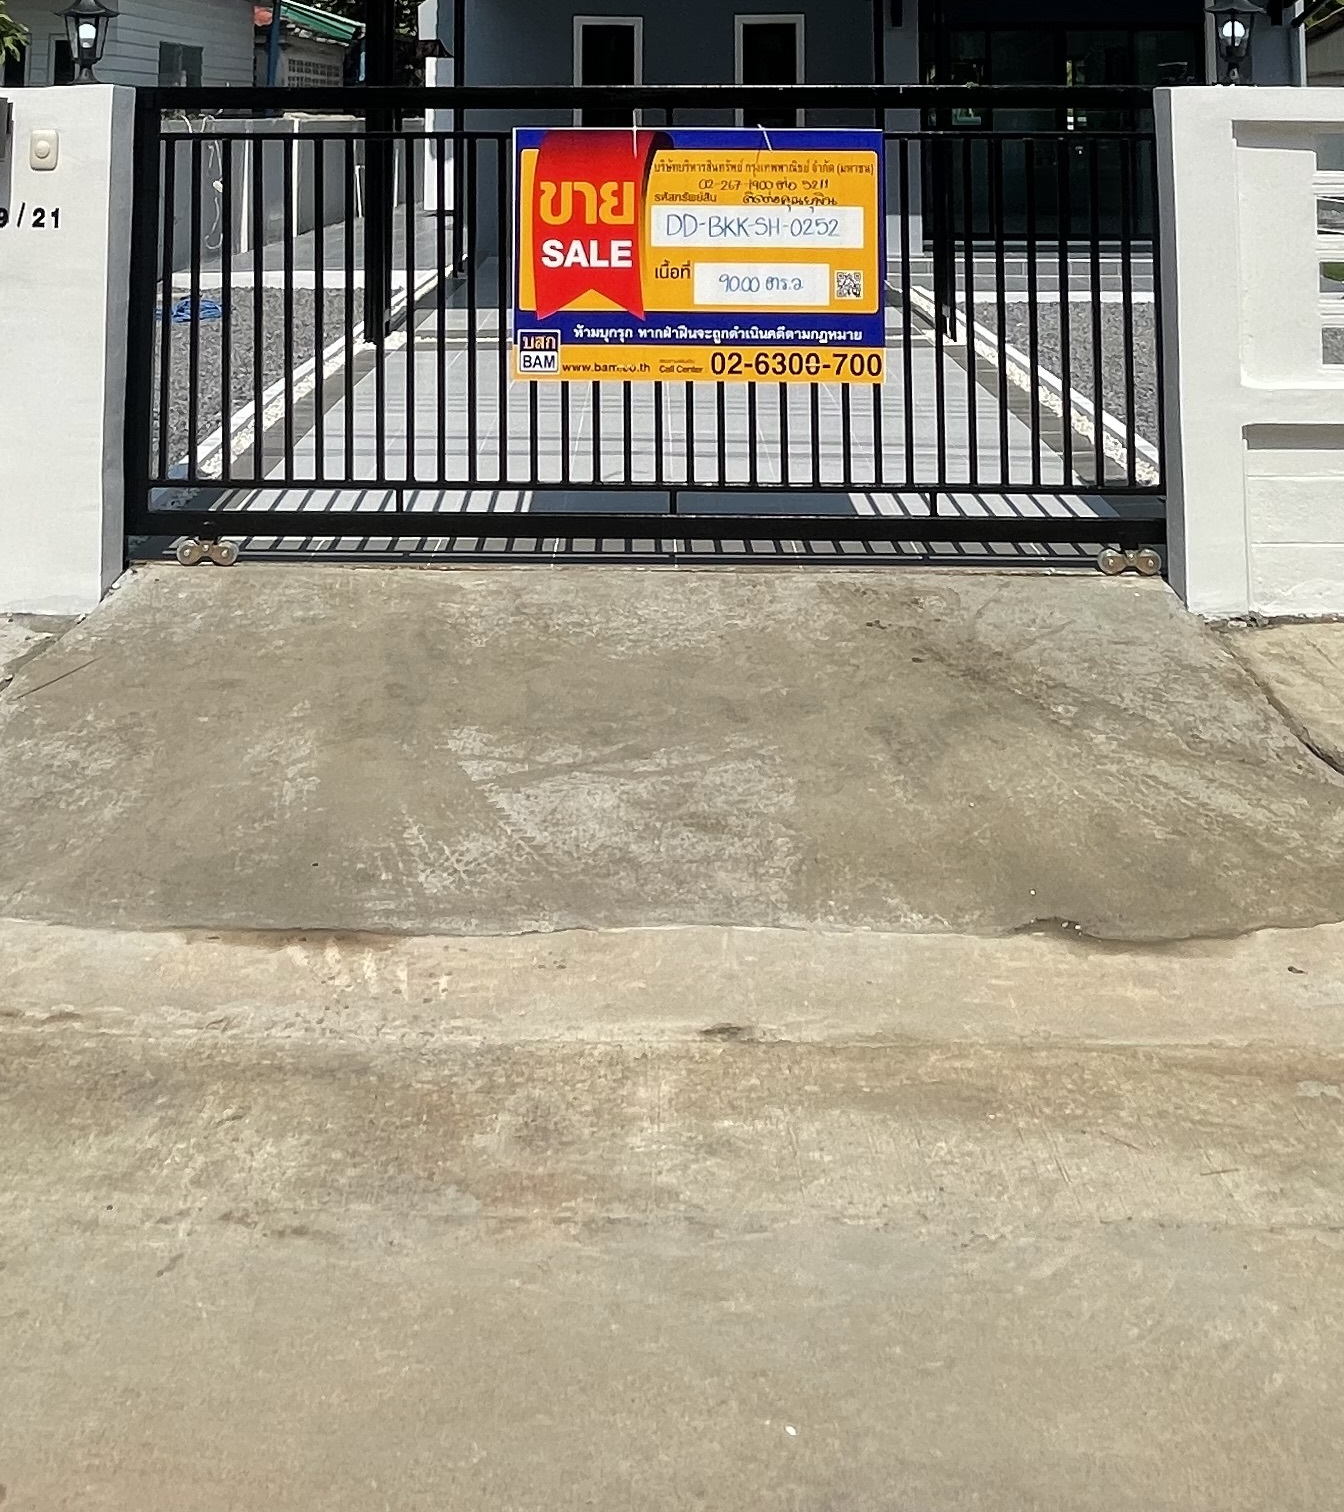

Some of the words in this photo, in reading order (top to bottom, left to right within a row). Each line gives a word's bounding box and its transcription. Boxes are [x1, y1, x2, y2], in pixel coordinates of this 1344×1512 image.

[539, 181, 635, 226] ขาย
[666, 213, 840, 239] DD-BKK-SH-0252
[541, 239, 633, 268] SALE
[654, 259, 692, 280] เนื้อที่
[523, 335, 556, 350] บสก
[573, 323, 634, 344] ห้ามบุกรุก
[522, 355, 556, 369] BAM
[711, 351, 883, 377] 02-6300-700
